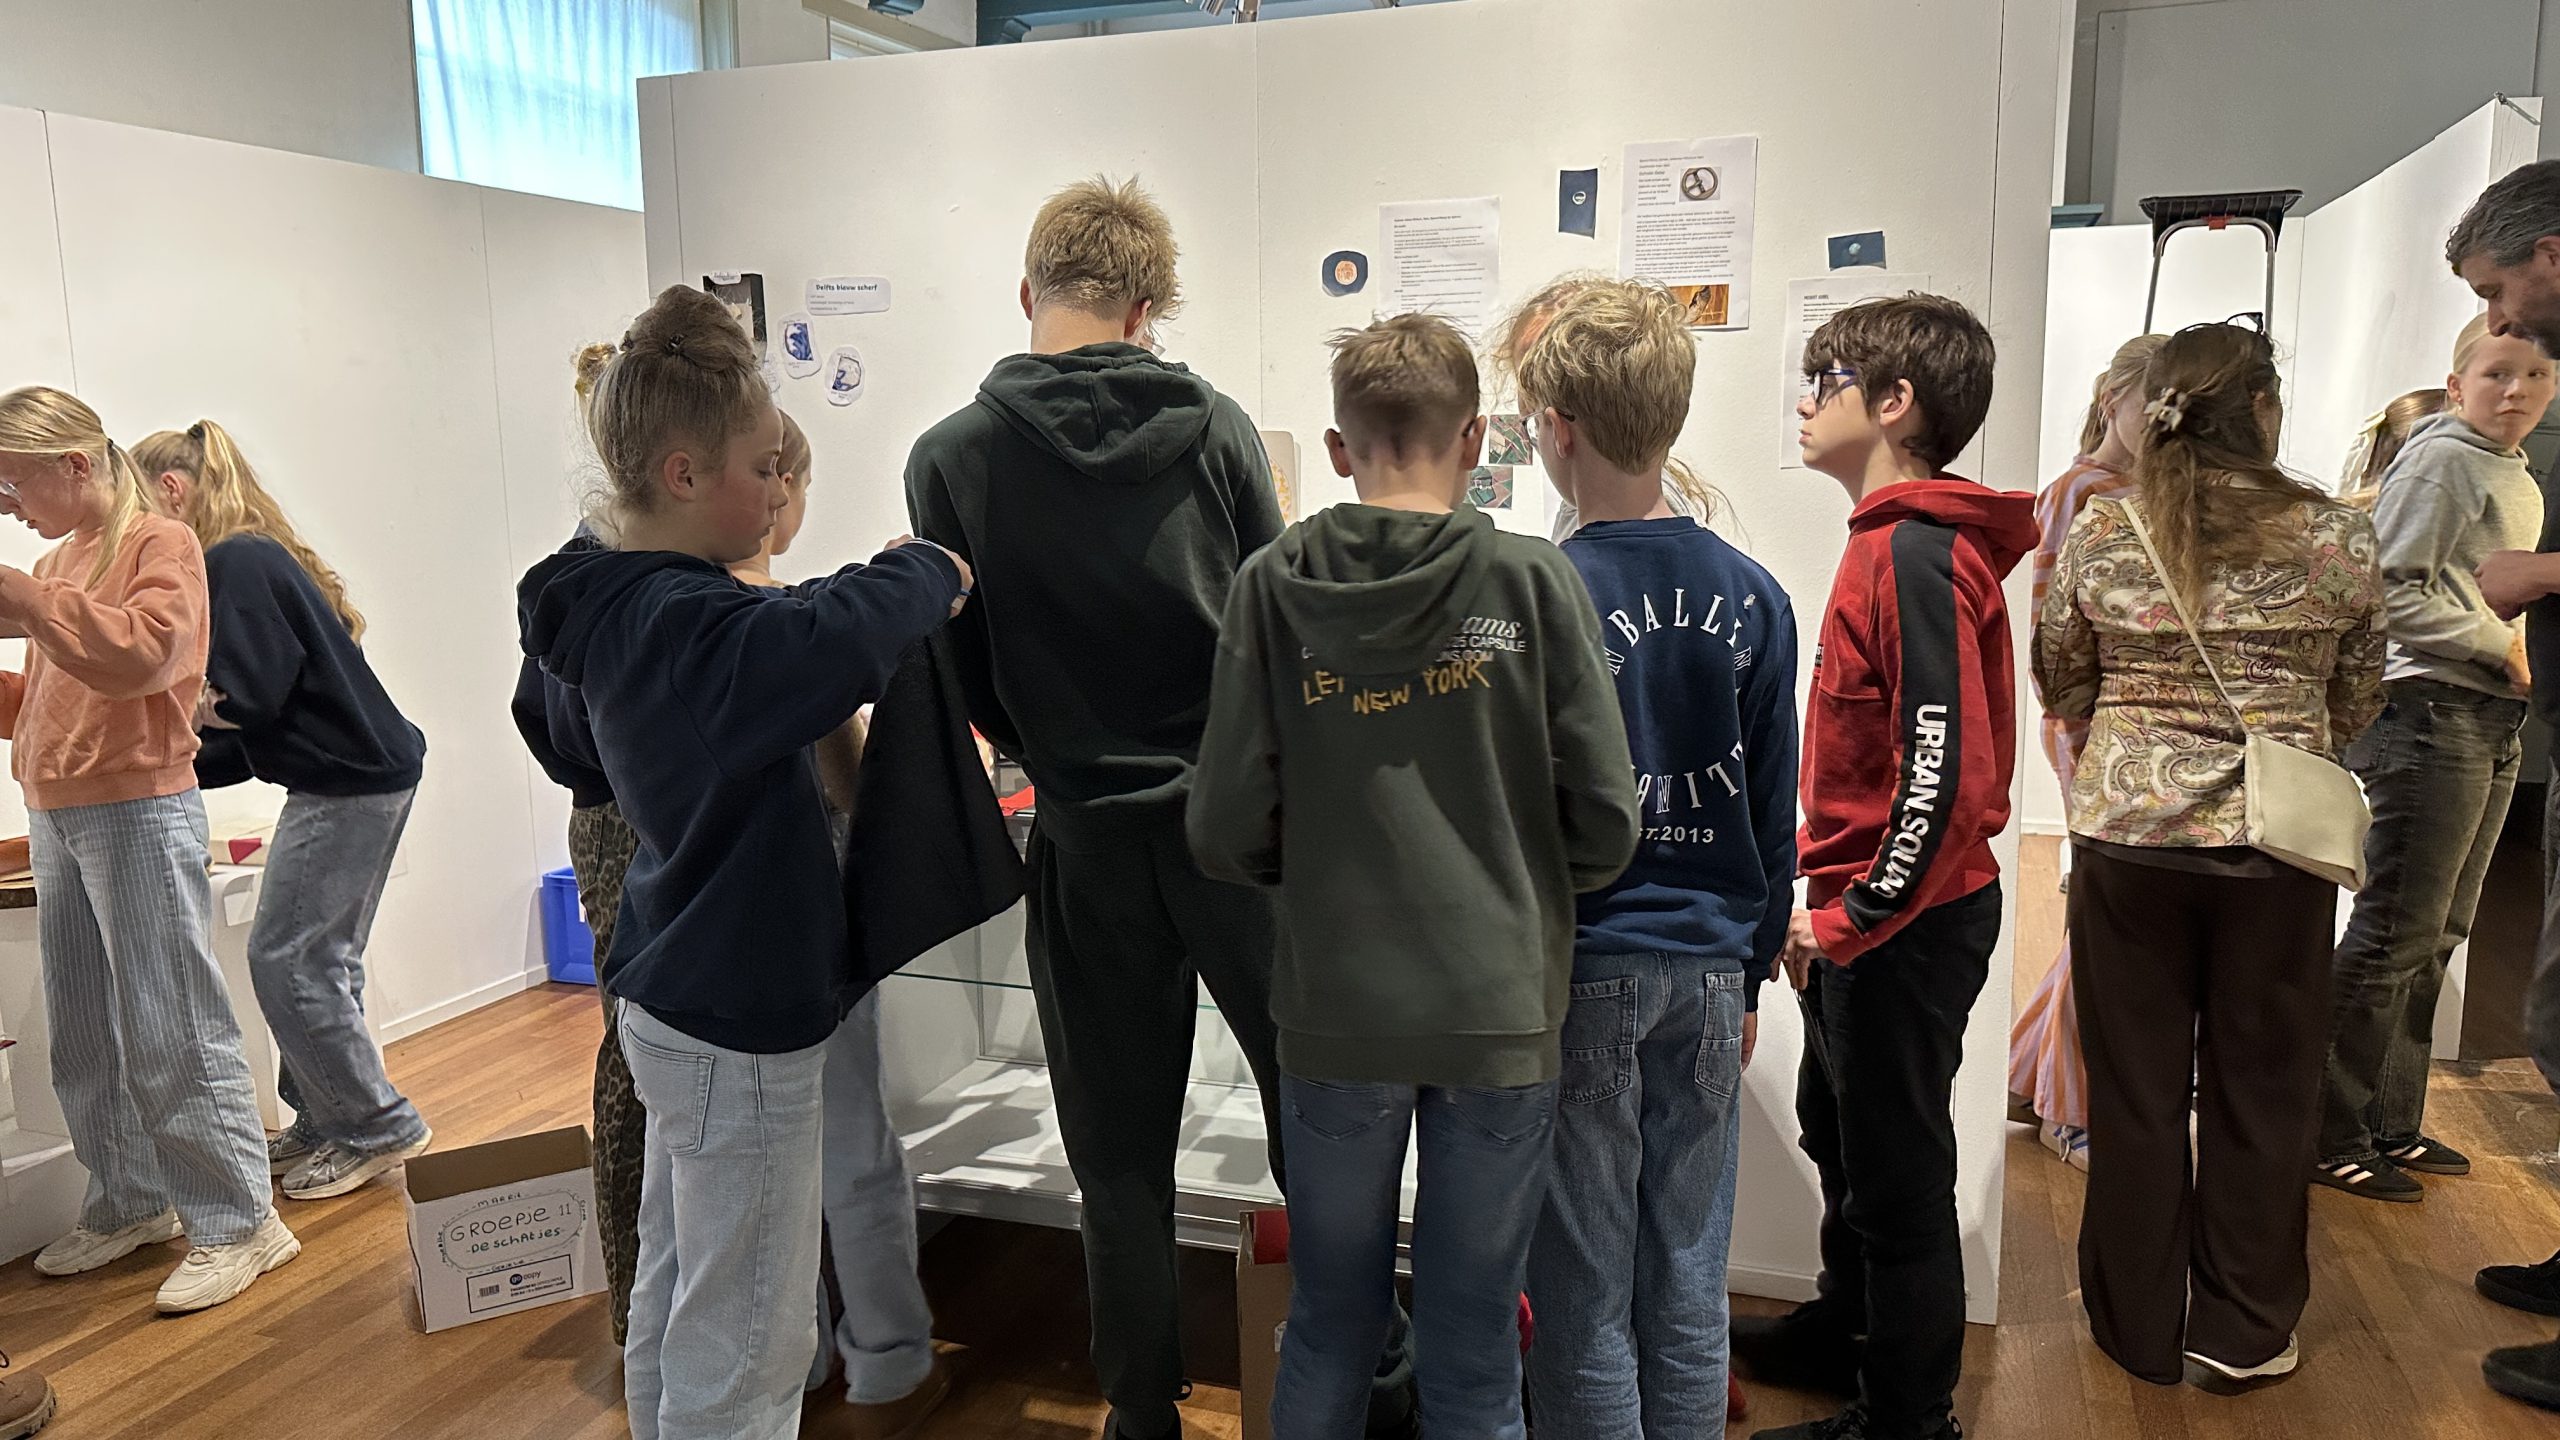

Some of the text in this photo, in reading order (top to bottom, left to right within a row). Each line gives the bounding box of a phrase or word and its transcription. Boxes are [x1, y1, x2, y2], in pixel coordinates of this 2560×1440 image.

[1468, 636, 1527, 652] CAPSULE
[1352, 683, 1411, 715] NEW
[1421, 659, 1493, 696] YORK
